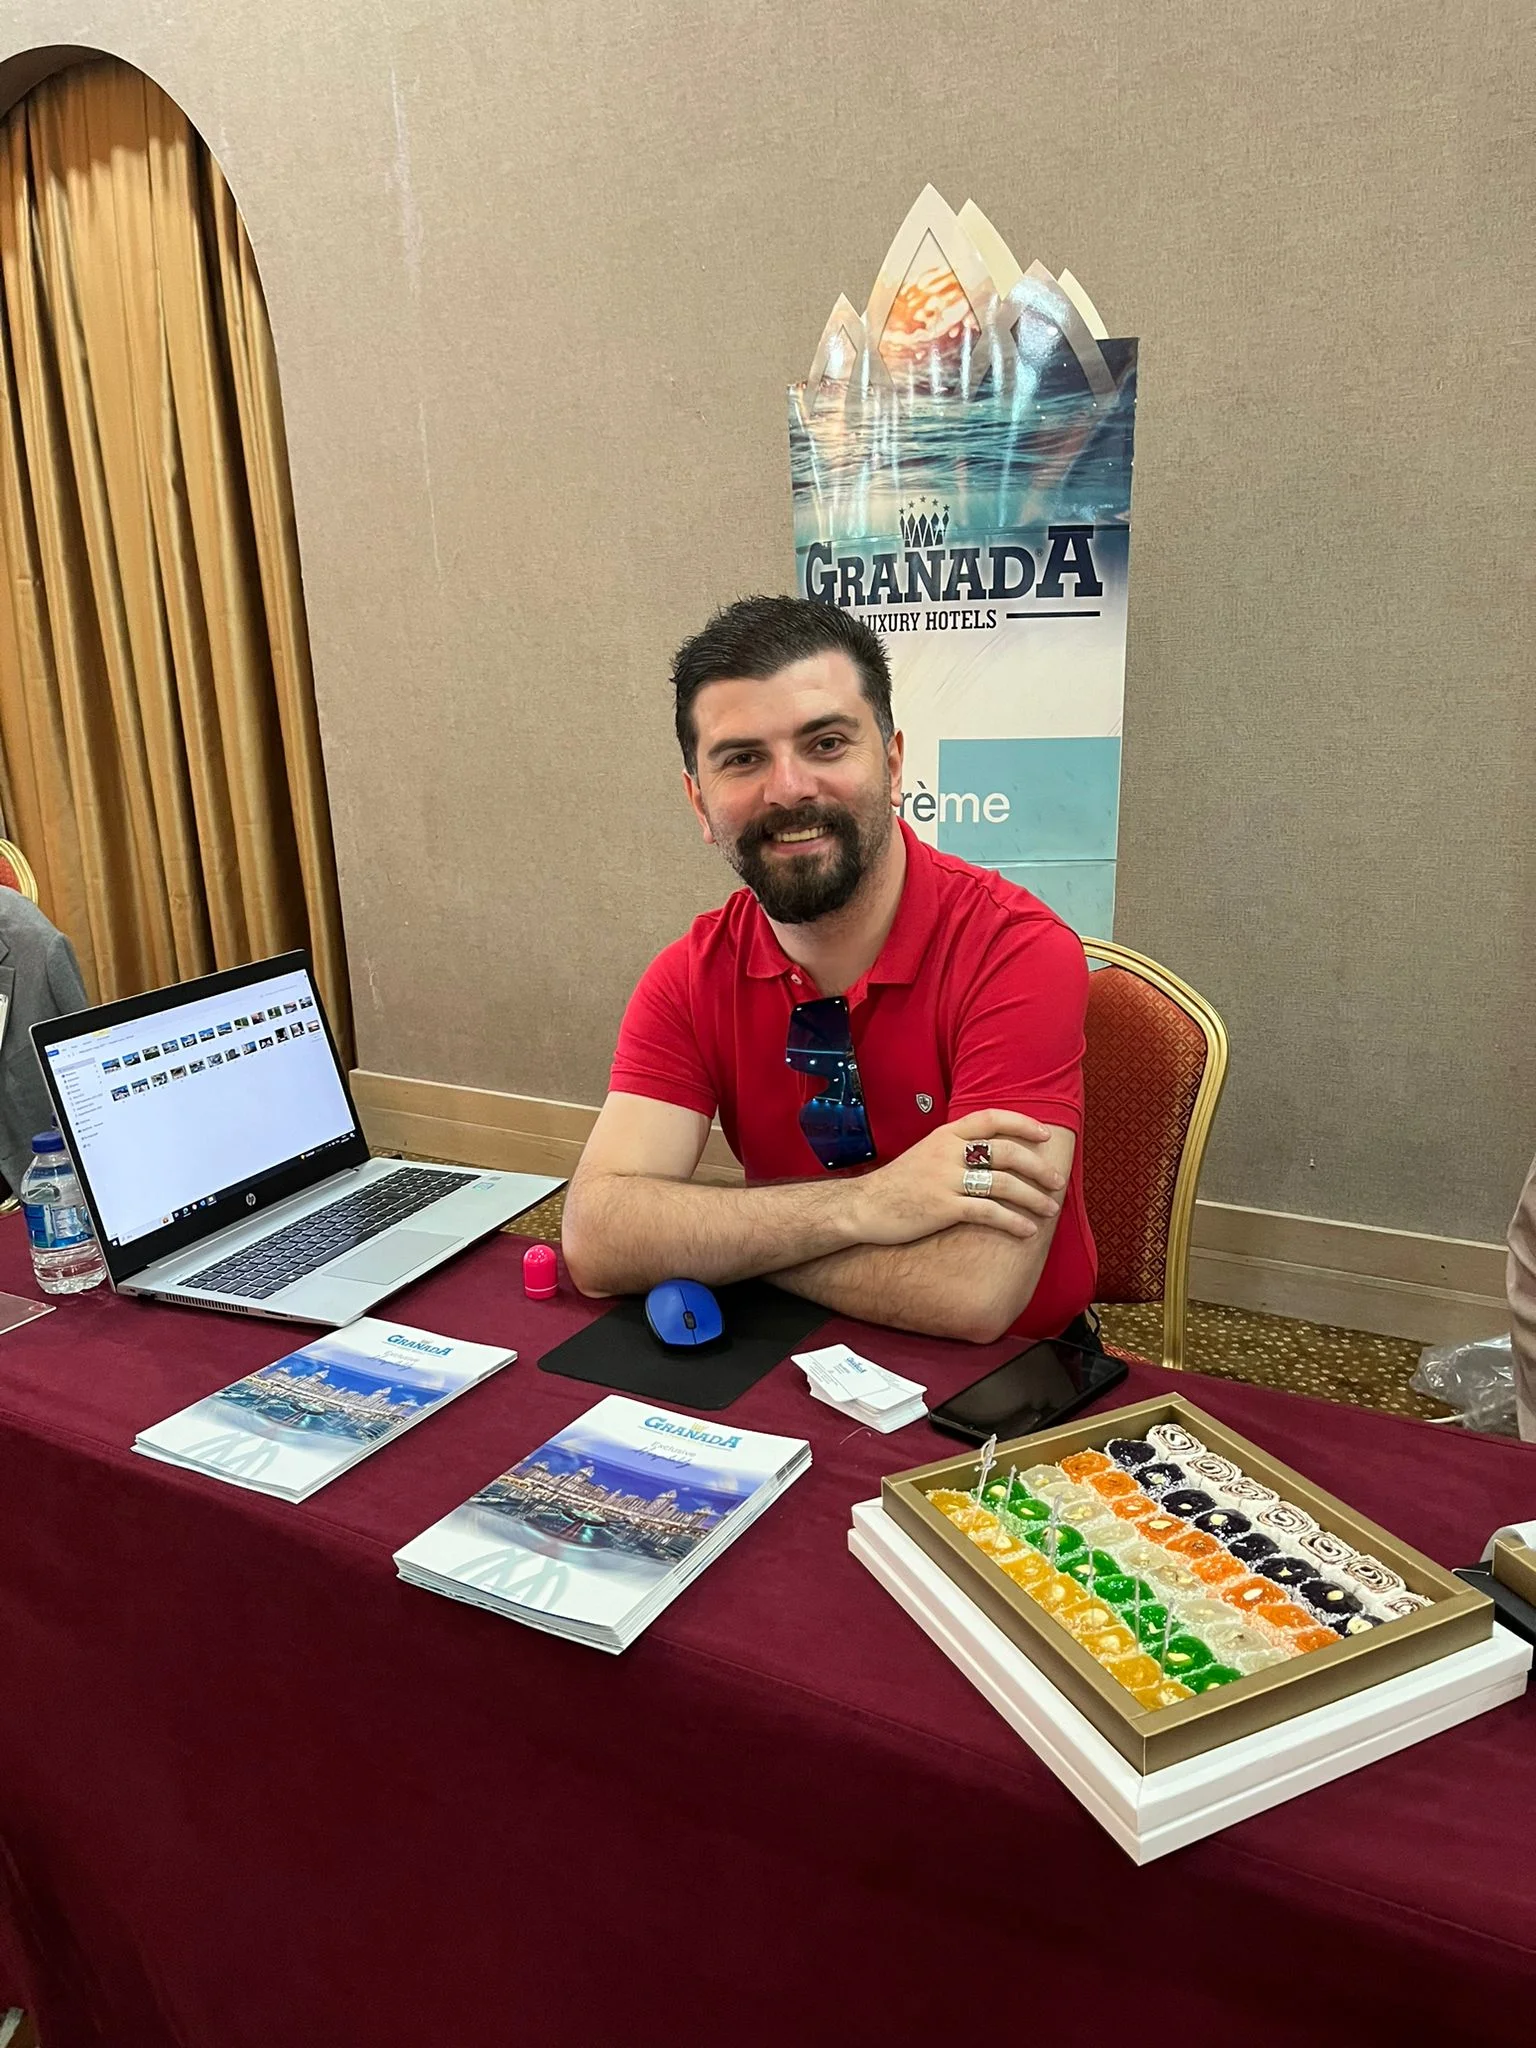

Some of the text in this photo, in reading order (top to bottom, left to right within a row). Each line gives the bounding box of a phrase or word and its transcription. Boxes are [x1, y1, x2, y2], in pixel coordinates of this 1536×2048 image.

[806, 525, 1103, 607] GRANADA
[925, 609, 997, 630] HOTELS
[387, 1334, 454, 1356] GRANADA
[644, 1416, 742, 1448] GRANADA
